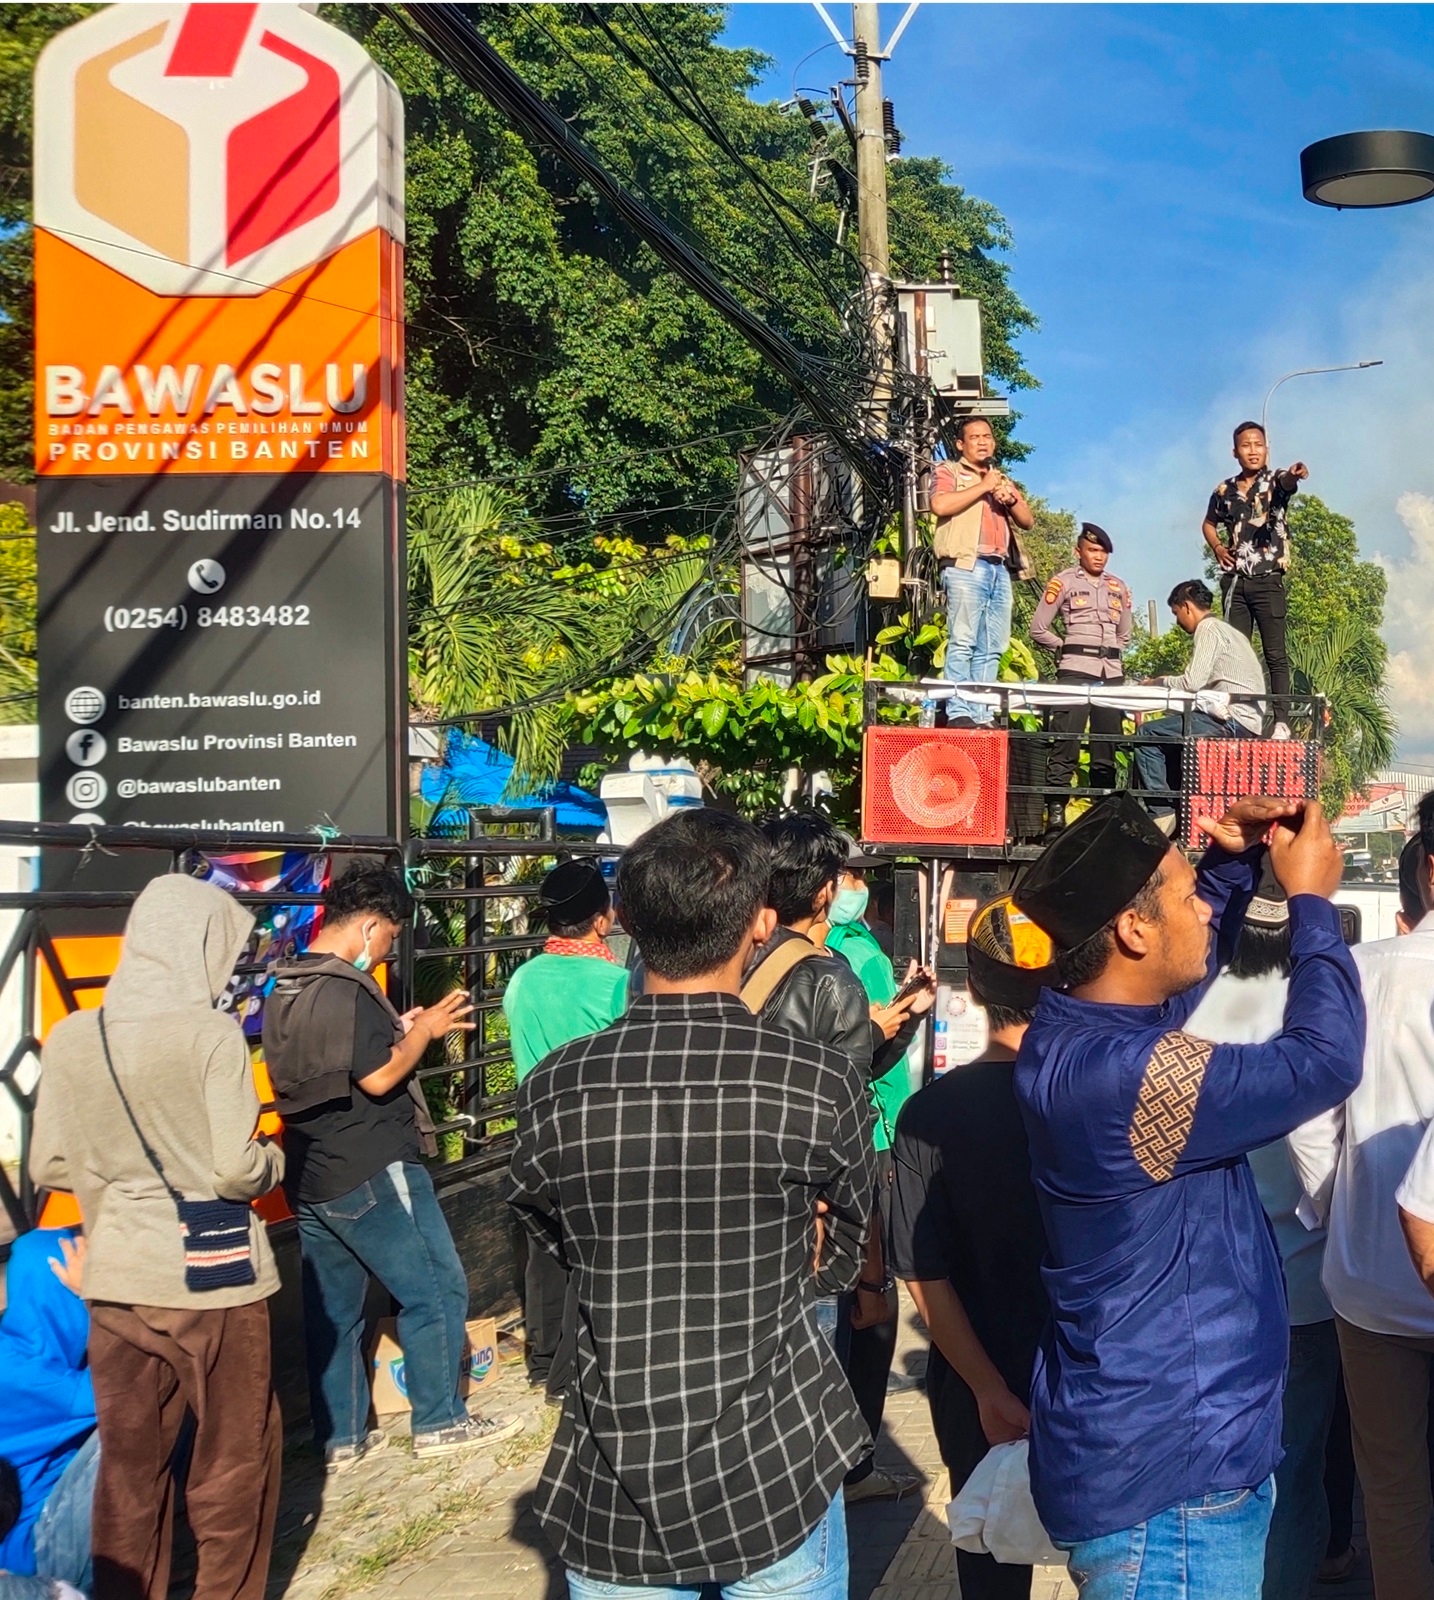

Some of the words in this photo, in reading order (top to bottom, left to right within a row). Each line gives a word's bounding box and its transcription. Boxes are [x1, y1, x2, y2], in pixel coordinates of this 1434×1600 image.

[45, 363, 367, 415] BAWASLU
[48, 423, 109, 436] BADAN
[114, 422, 210, 435] PENGAWAS
[216, 421, 312, 434] PEMILIHAN
[319, 420, 368, 433] UMUM
[49, 441, 217, 461] PROVINSI
[230, 440, 368, 460] BANTEN
[50, 512, 81, 533] Jl.
[87, 511, 156, 532] Jend.
[163, 510, 282, 531] Sudirman
[291, 508, 361, 530] No.14
[104, 605, 188, 632] (0254)
[197, 605, 310, 627] 8483482
[118, 690, 321, 710] banten.bawaslu.go.id
[118, 737, 199, 753] Bawaslu
[204, 735, 283, 752] Provinsi
[288, 733, 357, 750] Banten
[1196, 740, 1305, 795] WHITE
[117, 776, 281, 798] @bawaslubanten
